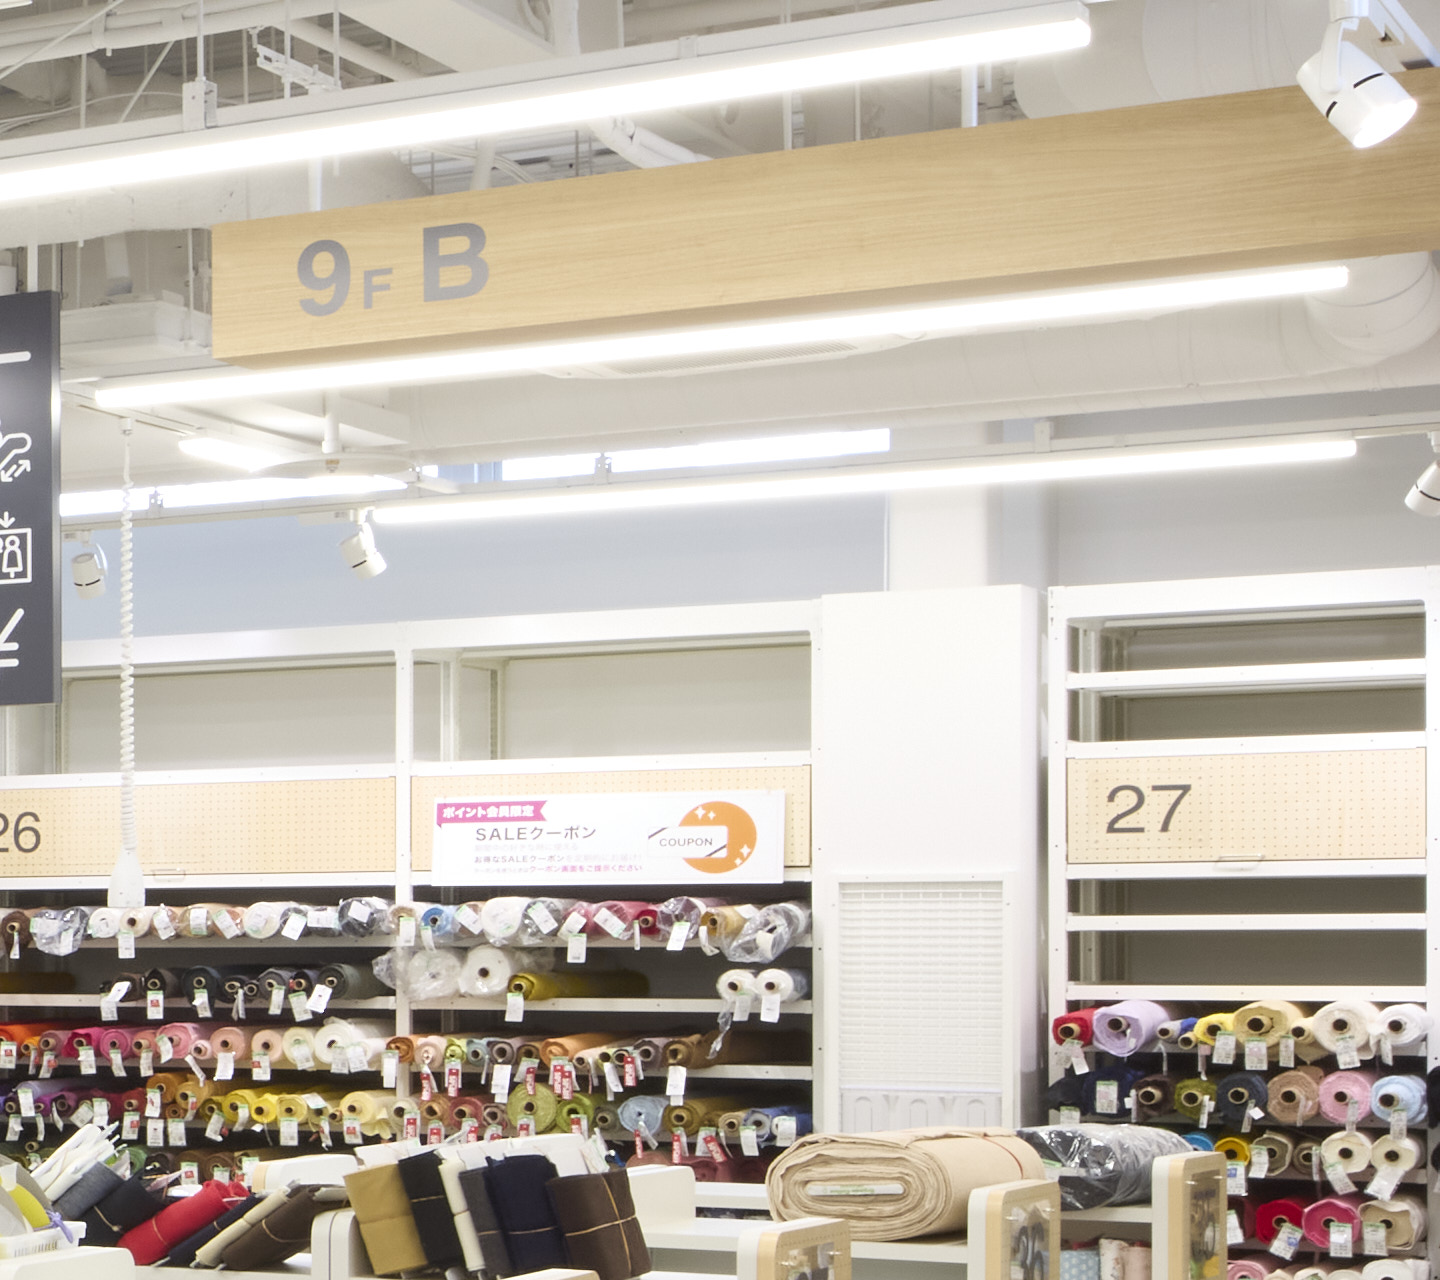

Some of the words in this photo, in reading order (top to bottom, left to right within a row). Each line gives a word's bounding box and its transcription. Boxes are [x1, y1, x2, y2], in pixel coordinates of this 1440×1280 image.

[297, 238, 393, 318] 9F
[423, 221, 491, 303] B
[443, 805, 534, 818] ポイント会員限定
[1106, 783, 1193, 833] 27
[476, 826, 596, 841] SALEクーポン
[659, 837, 713, 848] COUPON
